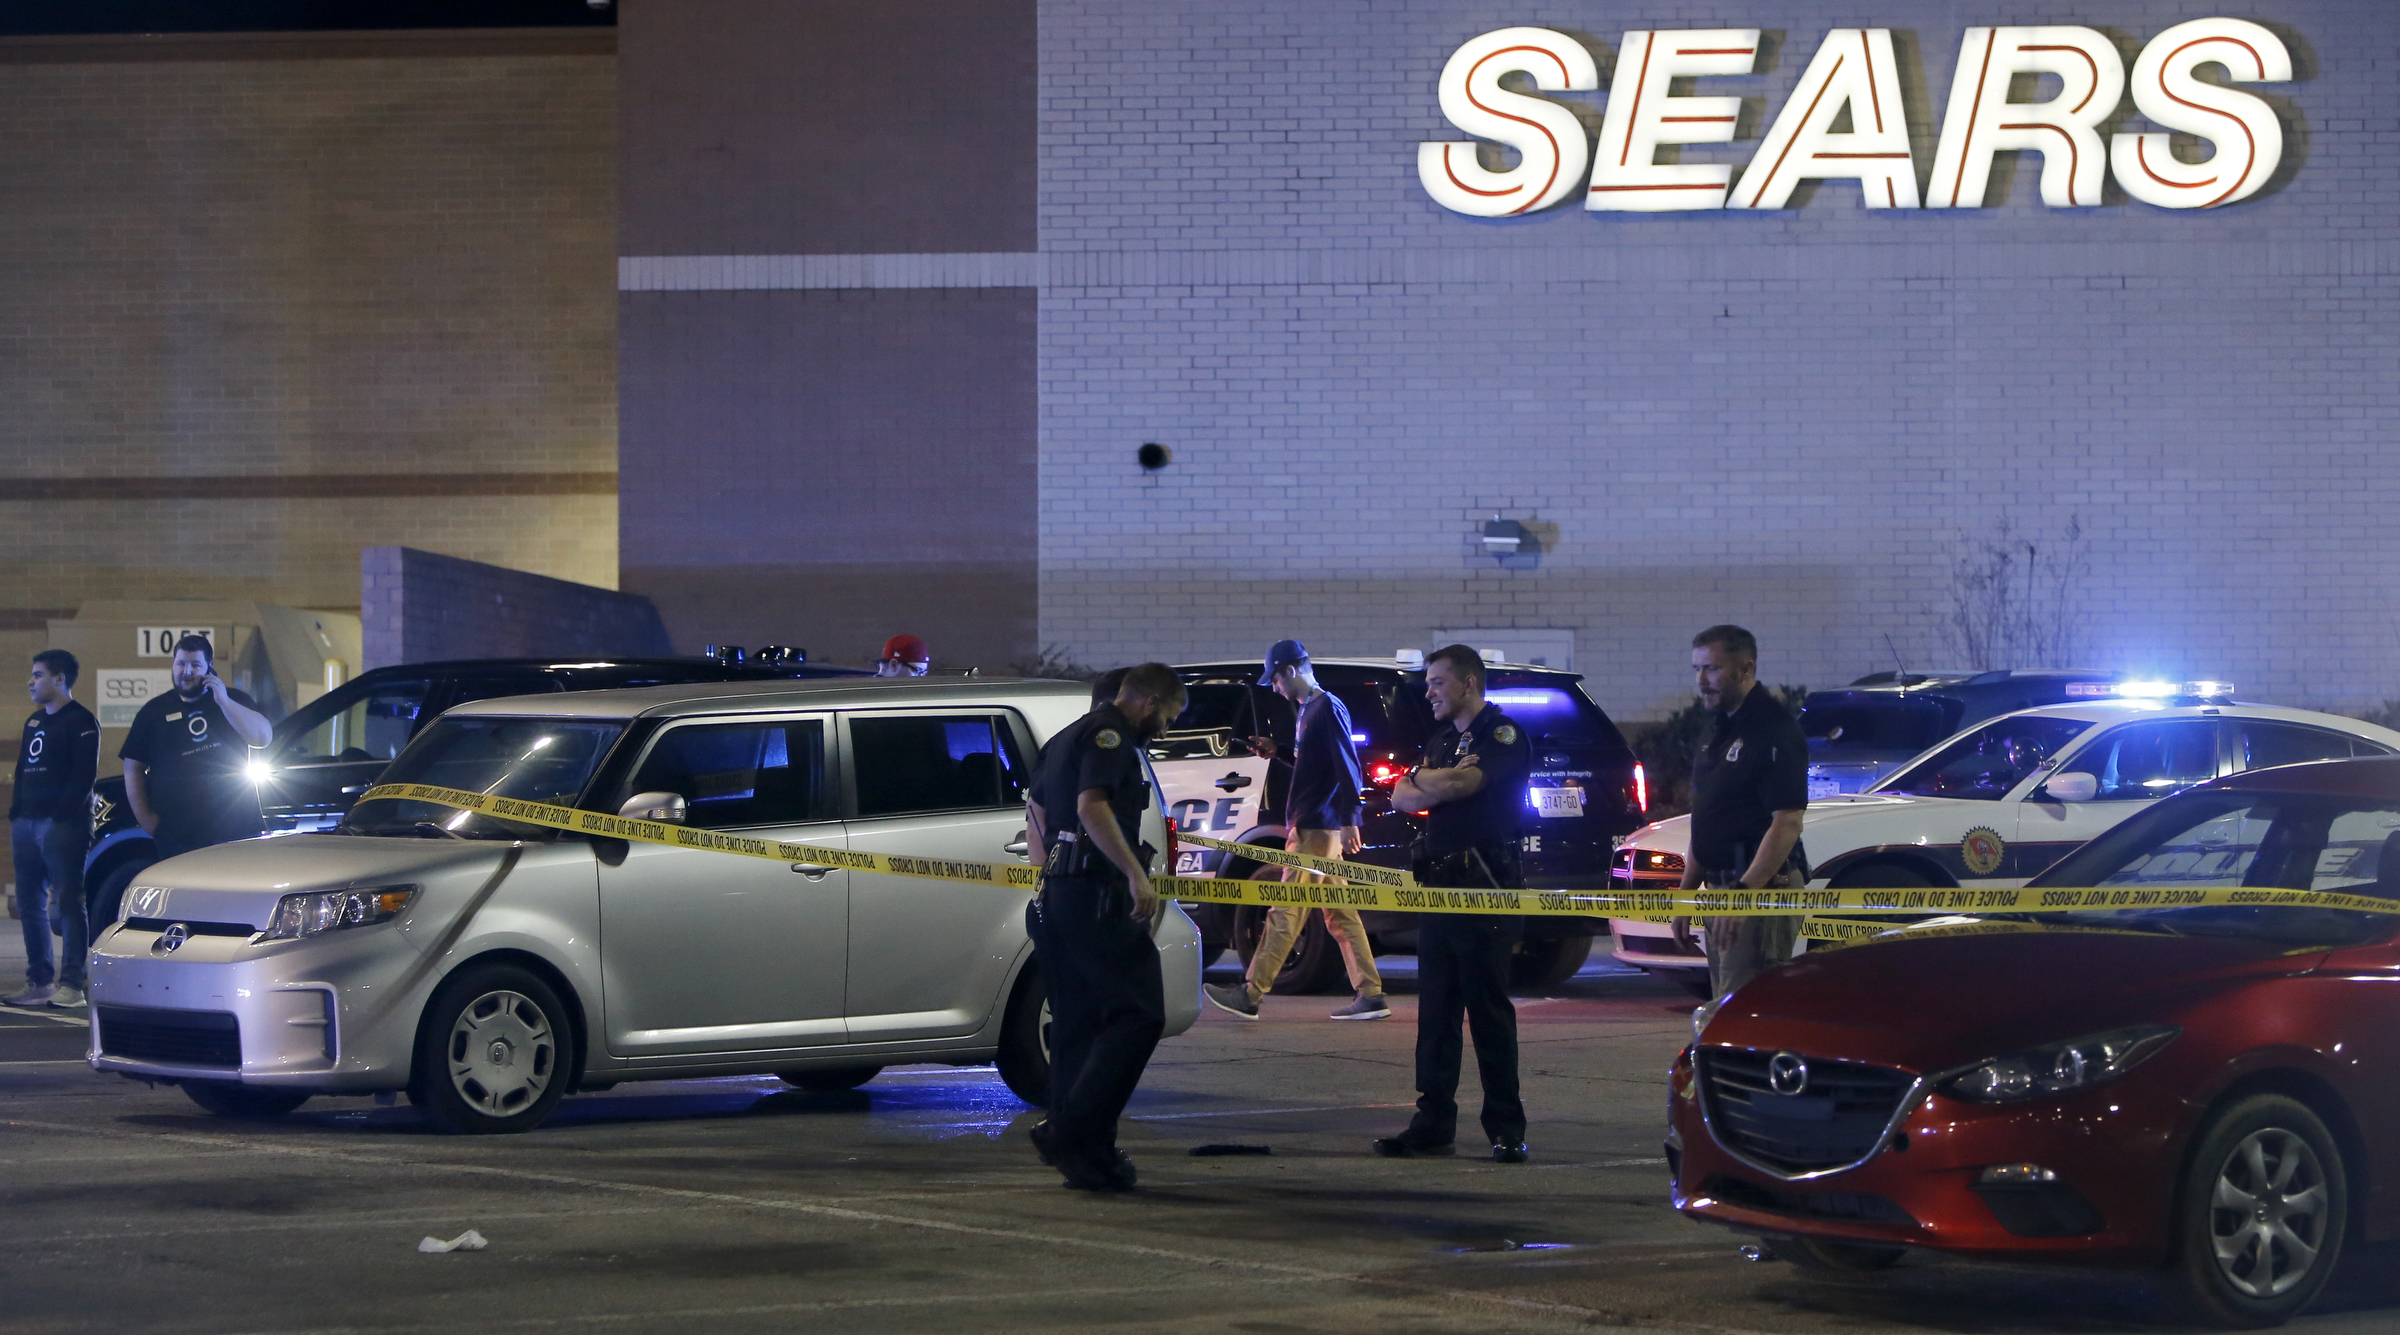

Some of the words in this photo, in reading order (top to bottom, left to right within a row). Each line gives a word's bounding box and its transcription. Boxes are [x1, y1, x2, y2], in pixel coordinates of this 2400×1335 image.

[1417, 17, 2293, 218] SEARS
[106, 678, 148, 698] SSG
[1567, 770, 1593, 778] Integrity
[492, 799, 515, 815] CROSS
[512, 802, 529, 817] NOT
[527, 803, 539, 818] DO
[536, 805, 551, 822] LINE
[549, 808, 574, 825] POLICE
[582, 813, 602, 829] CROSS
[603, 816, 615, 833] NOT
[616, 819, 627, 834] DO
[627, 821, 642, 837] LINE
[642, 823, 666, 840] POLICE
[677, 829, 699, 845] CROSS
[700, 832, 713, 848] NOT
[714, 834, 725, 849] DO
[726, 836, 741, 851] LINE
[742, 839, 767, 856] POLICE
[778, 844, 803, 860] CROSS
[804, 847, 818, 863] NOT
[819, 849, 831, 864] DO
[832, 851, 849, 866] LINE
[849, 852, 876, 869] POLICE
[888, 857, 915, 873] CROSS
[915, 859, 932, 875] NOT
[932, 861, 944, 876] DO
[945, 862, 964, 878] LINE
[964, 863, 992, 881] POLICE
[1312, 859, 1337, 876] POLICE
[1337, 864, 1352, 879] LINE
[1354, 866, 1364, 880] DO
[1365, 868, 1379, 883] NOT
[1379, 870, 1403, 887] CROSS
[1007, 867, 1033, 885] CROSS
[1160, 879, 1175, 895] NOT
[1177, 880, 1189, 896] DO
[1192, 880, 1211, 898] LINE
[1213, 881, 1242, 899] POLICE
[1258, 884, 1288, 901] CROSS
[1290, 886, 1306, 902] NOT
[1309, 887, 1321, 902] DO
[1324, 887, 1344, 904] LINE
[1346, 888, 1378, 905] POLICE
[1395, 890, 1424, 907] CROSS
[1428, 891, 1446, 908] NOT
[1447, 892, 1462, 908] DO
[1463, 892, 1485, 909] LINE
[1487, 892, 1521, 909] POLICE
[1539, 893, 1572, 910] CROSS
[1575, 894, 1594, 910] NOT
[1597, 894, 1610, 911] DO
[1614, 893, 1636, 911] LINE
[1638, 893, 1673, 911] POLICE
[1694, 893, 1728, 911] CROSS
[1732, 893, 1753, 910] NOT
[1756, 893, 1771, 910] DO
[1774, 893, 1800, 909] LINE
[1801, 892, 1841, 909] POLICE
[1862, 892, 1900, 909] CROSS
[1902, 892, 1926, 907] NOT
[1928, 891, 1946, 907] DO
[1947, 891, 1975, 907] LINE
[1977, 890, 2020, 906] POLICE
[2041, 891, 2082, 906] CROSS
[2082, 891, 2109, 906] NOT
[2110, 891, 2130, 905] DO
[2130, 891, 2161, 905] LINE
[2160, 890, 2207, 904] POLICE
[2227, 891, 2272, 903] CROSS
[2272, 892, 2296, 902] NOT
[2300, 892, 2321, 903] DO
[2320, 893, 2352, 905] LINE
[1800, 922, 1821, 937] LINE
[1822, 923, 1834, 938] DO
[1836, 924, 1853, 938] NOT
